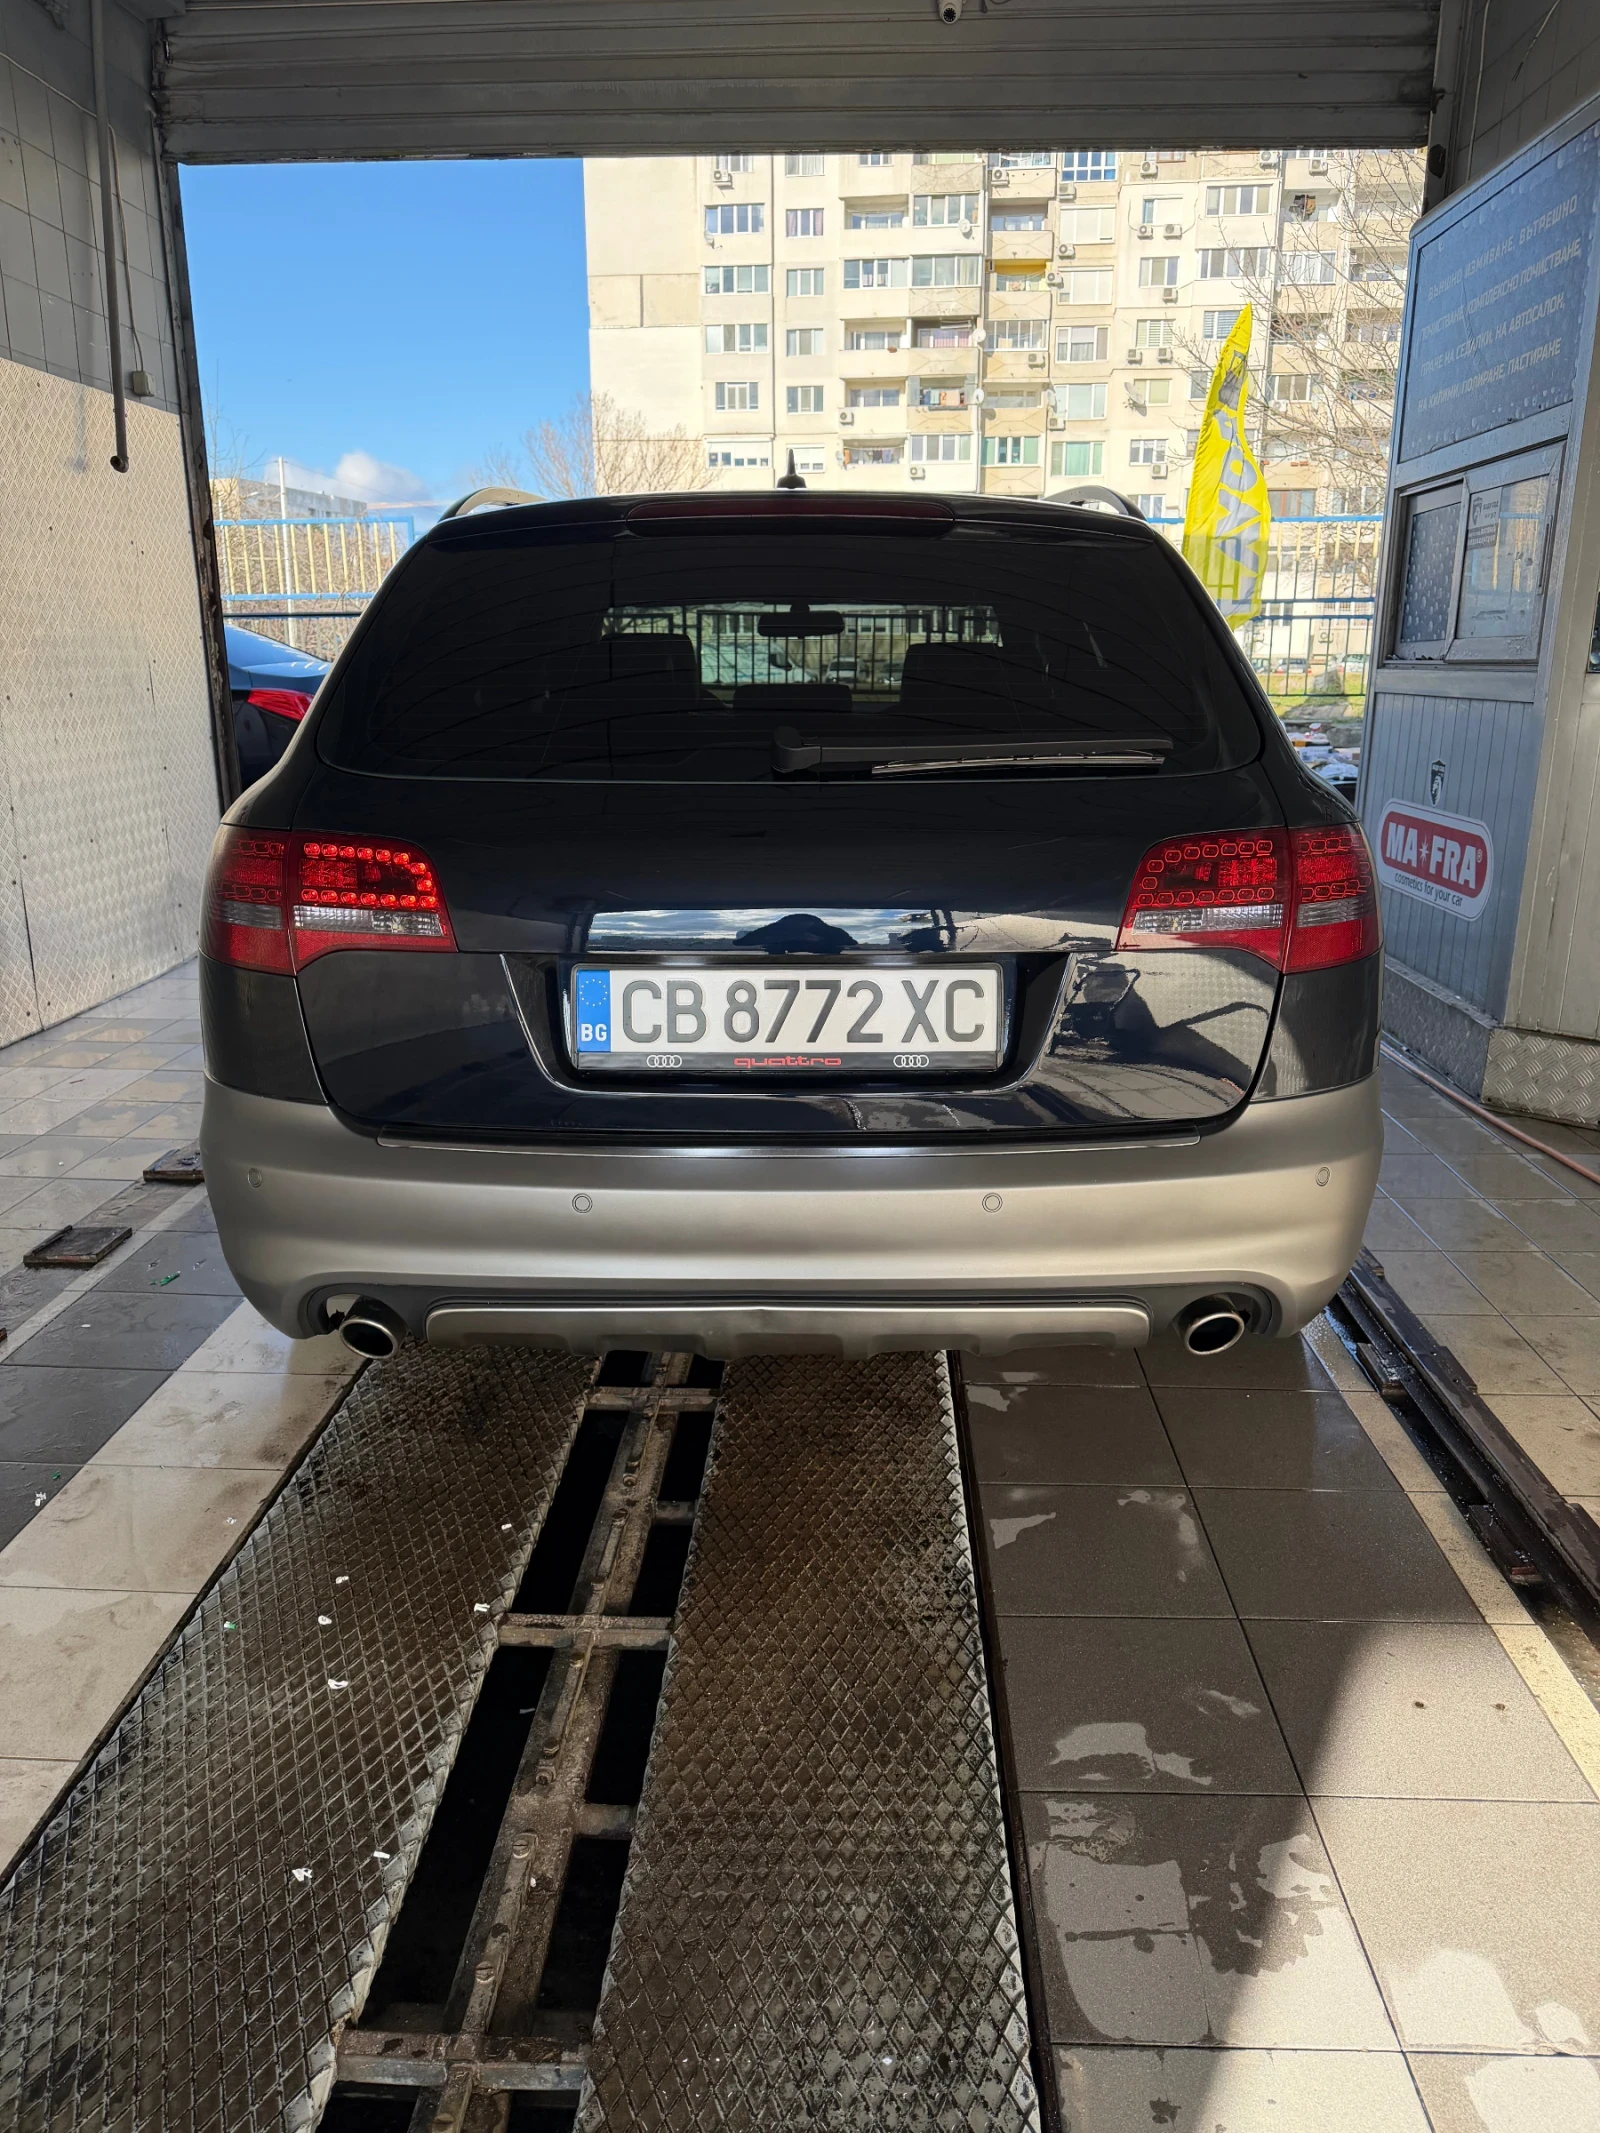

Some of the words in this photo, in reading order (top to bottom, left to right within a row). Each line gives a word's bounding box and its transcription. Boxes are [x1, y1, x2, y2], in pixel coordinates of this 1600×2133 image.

[1428, 267, 1463, 301] ВЪНШНО
[1519, 194, 1578, 246] ВЪТРЕШНО
[1466, 274, 1519, 316] КОМПЛЕКСНО
[1520, 237, 1582, 287] ПОЧИСТВАНЕ,
[1421, 354, 1444, 377] ПРАНЕ
[1445, 349, 1455, 365] НА
[1496, 321, 1507, 340] НА
[1509, 292, 1565, 334] АВТОСАЛОН,
[1417, 398, 1428, 413] НА
[1508, 337, 1562, 376] ПАСТИРАНЕ
[1395, 872, 1423, 892] cosmetics
[1424, 882, 1434, 896] for
[1435, 887, 1451, 903] your
[1451, 894, 1463, 907] car
[580, 1023, 607, 1041] BG
[622, 980, 707, 1043] CB
[723, 979, 884, 1043] 8772
[901, 979, 985, 1043] XC
[734, 1055, 841, 1068] quattro
